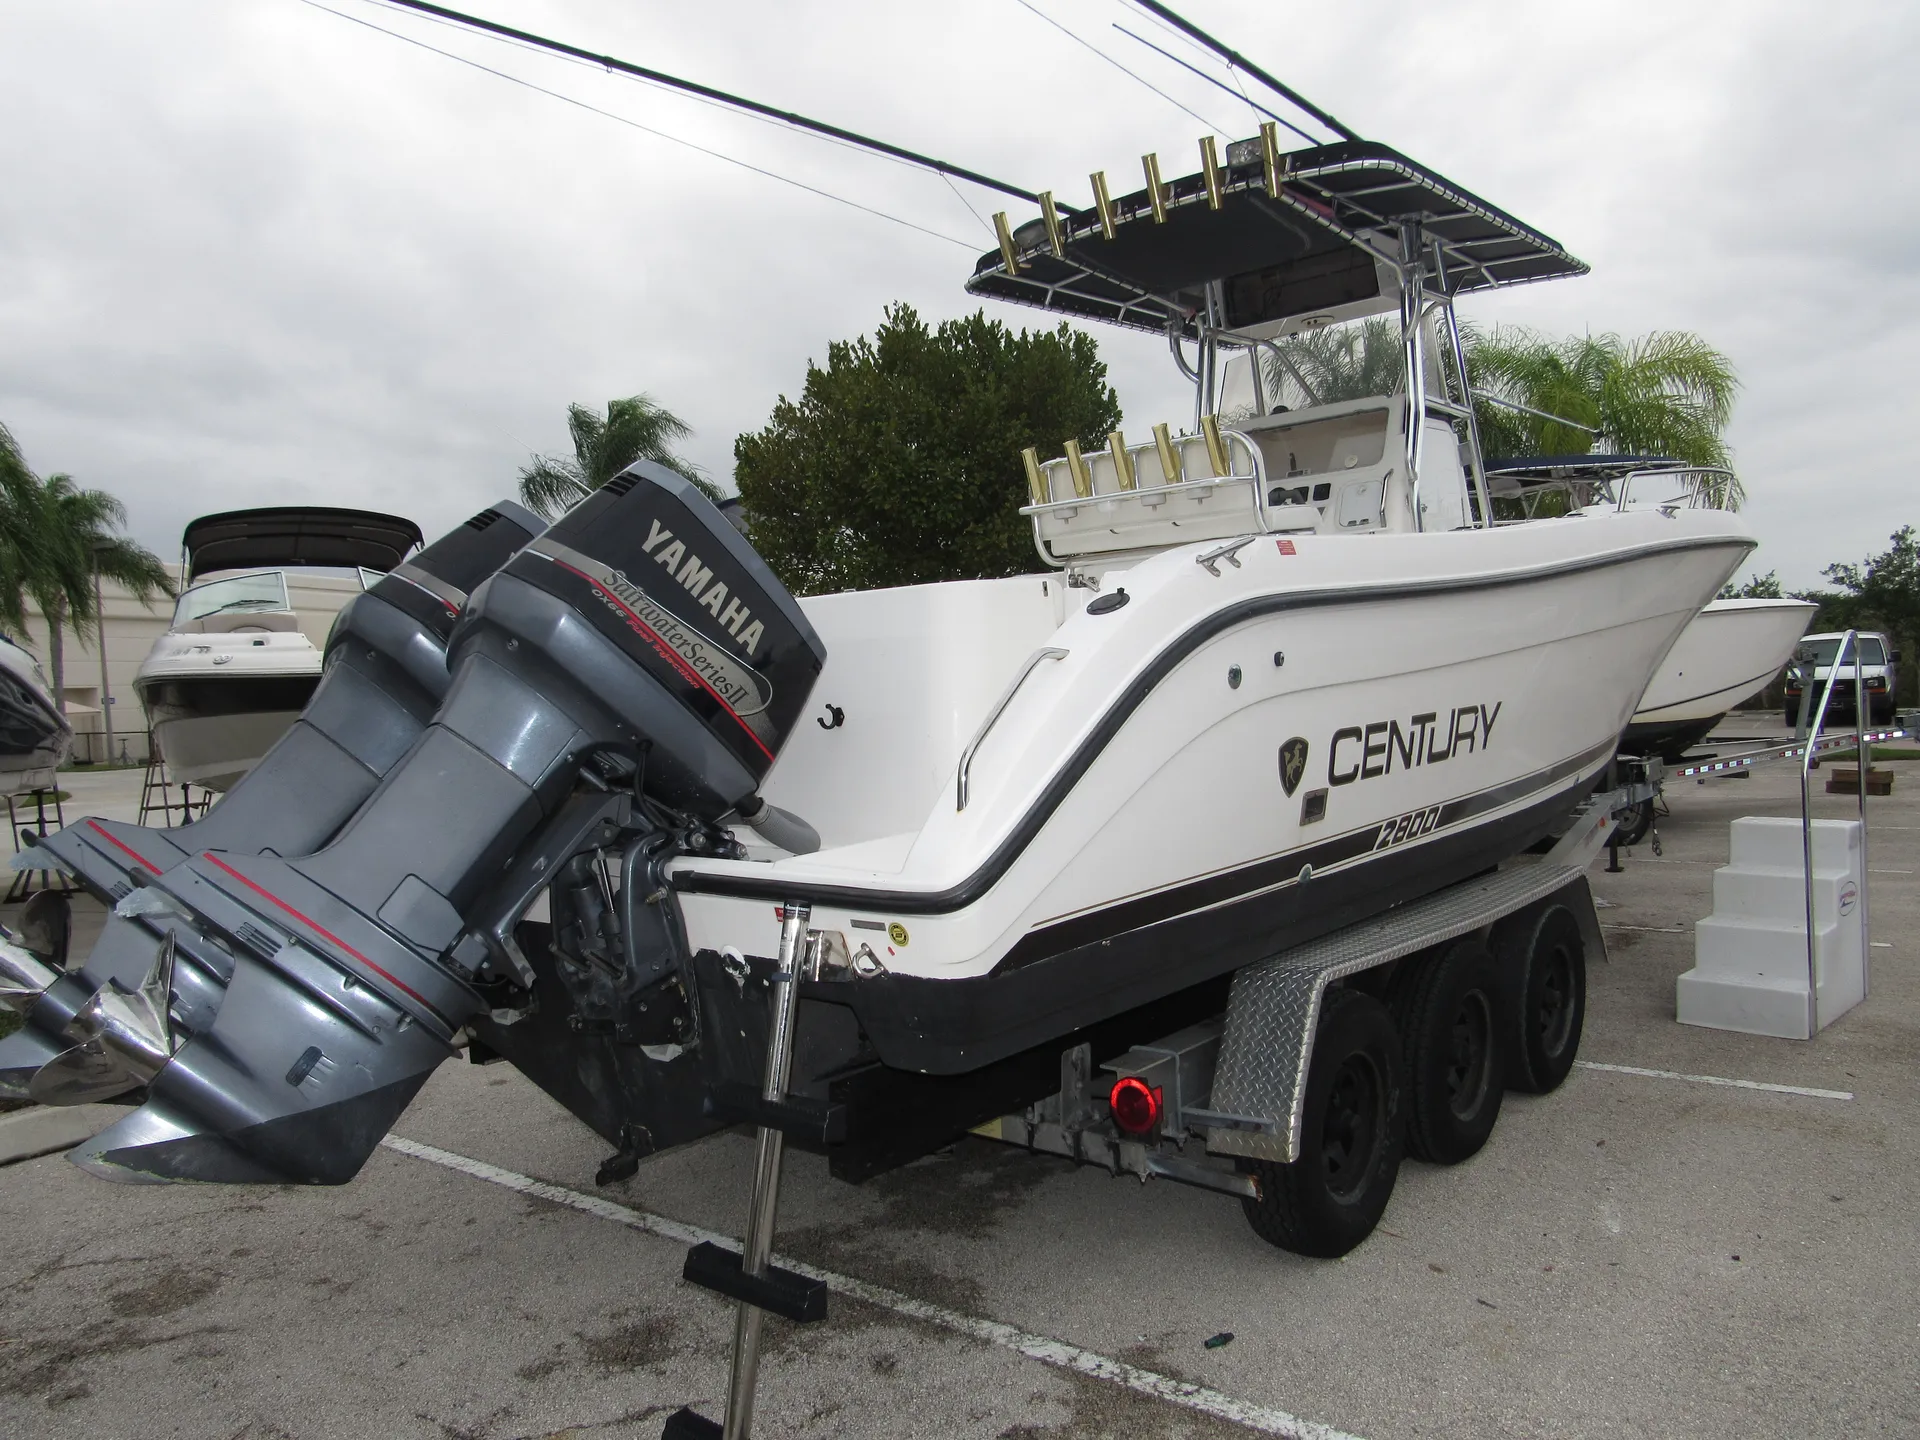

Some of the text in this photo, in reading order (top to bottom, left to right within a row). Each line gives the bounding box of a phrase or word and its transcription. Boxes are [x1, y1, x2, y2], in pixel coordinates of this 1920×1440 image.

[641, 518, 765, 656] YAMAHA
[626, 619, 653, 643] Fuel
[1328, 701, 1502, 787] CENTURY
[1375, 805, 1441, 851] 2800
